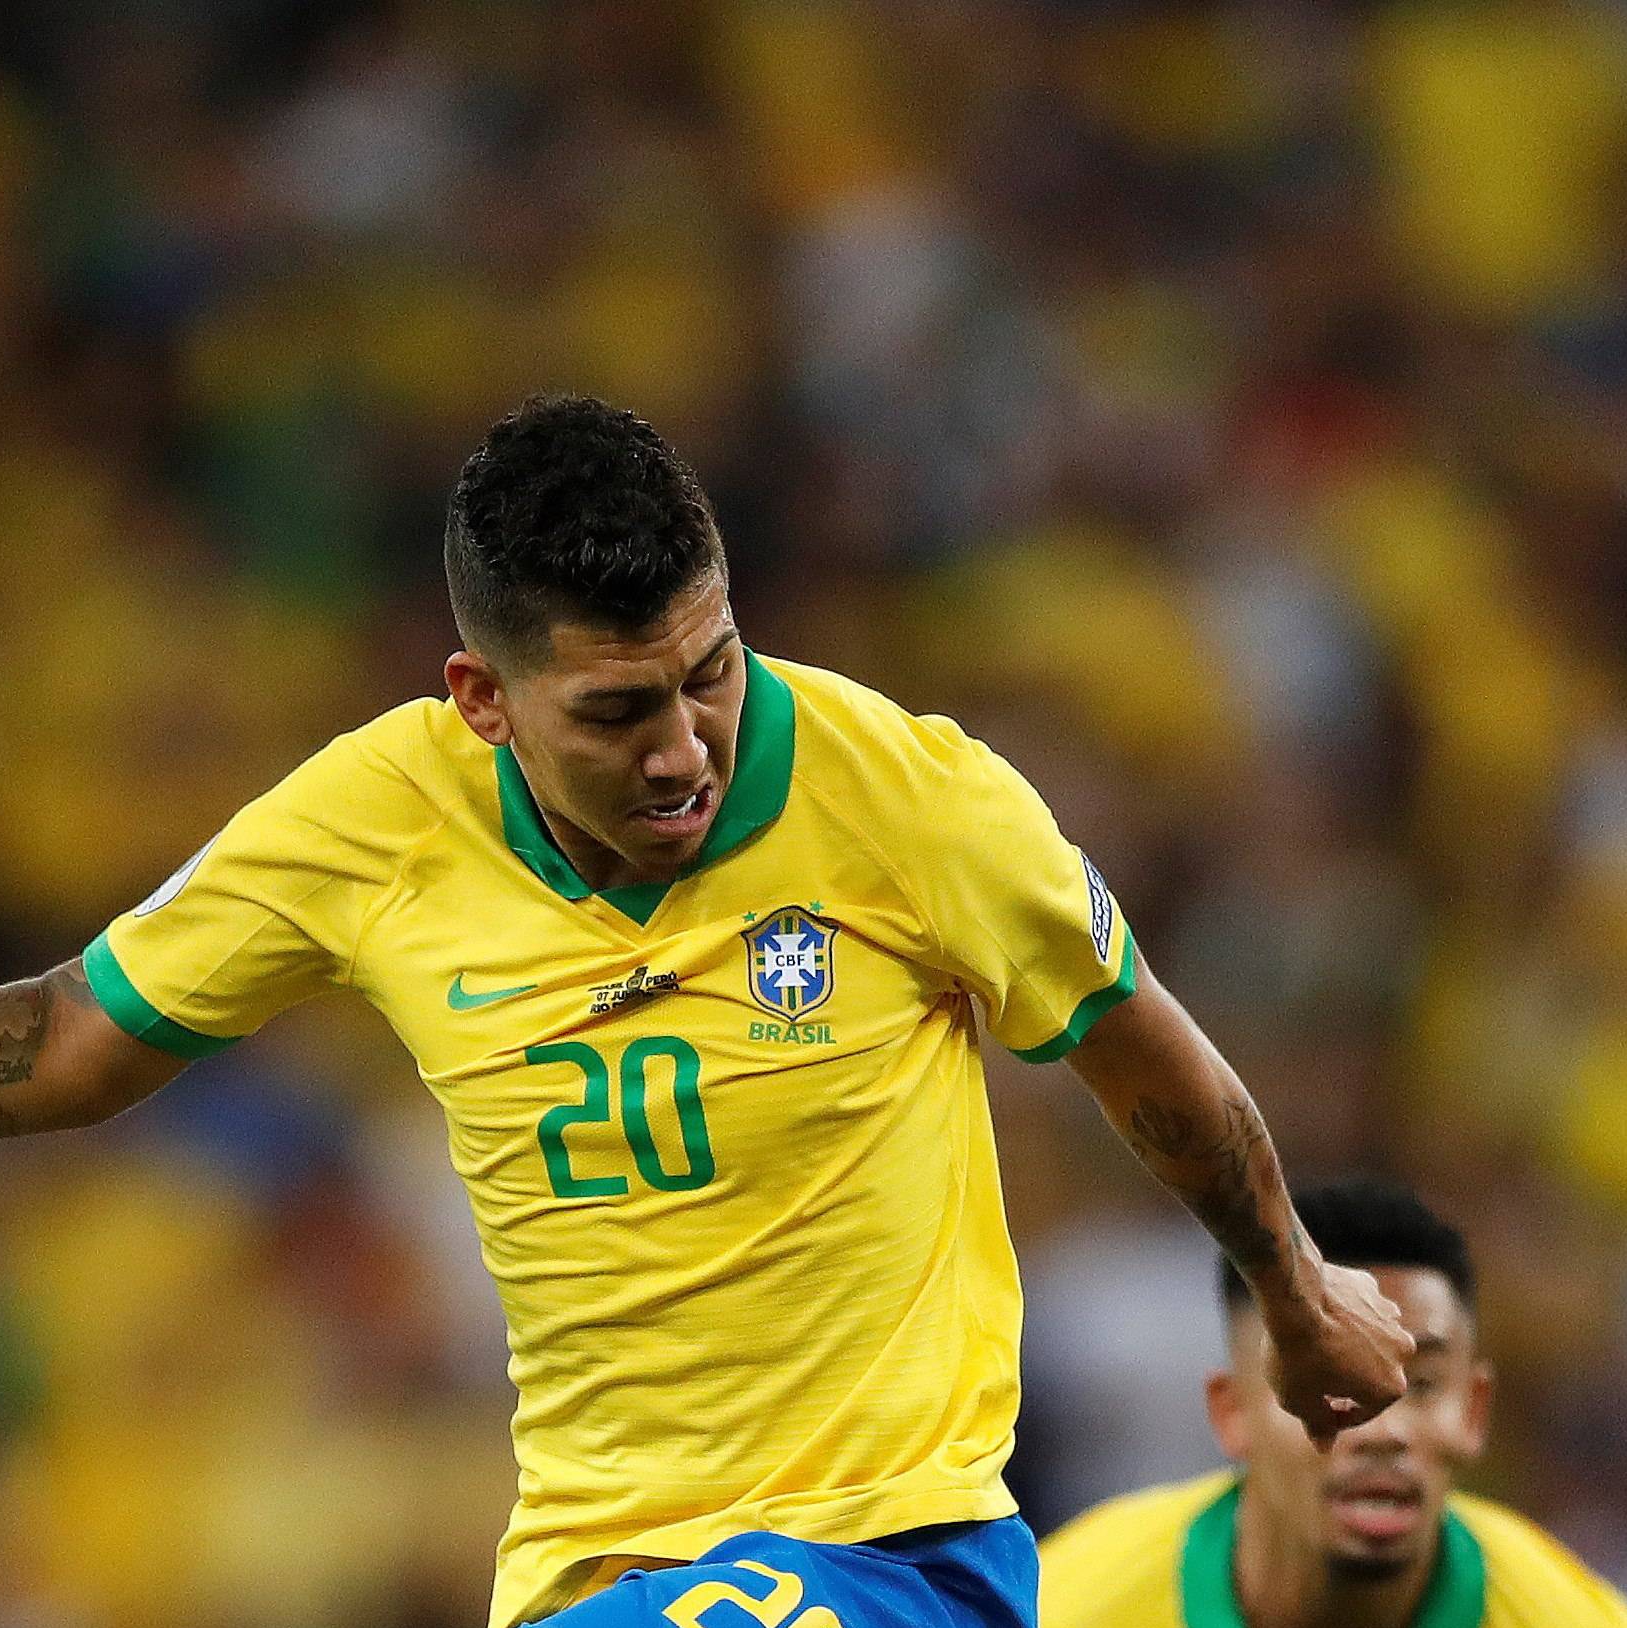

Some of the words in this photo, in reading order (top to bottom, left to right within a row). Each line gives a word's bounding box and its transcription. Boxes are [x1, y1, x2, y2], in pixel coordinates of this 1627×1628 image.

[775, 954, 805, 967] CBF
[748, 1022, 837, 1044] BRASIL
[524, 1035, 716, 1198] 20
